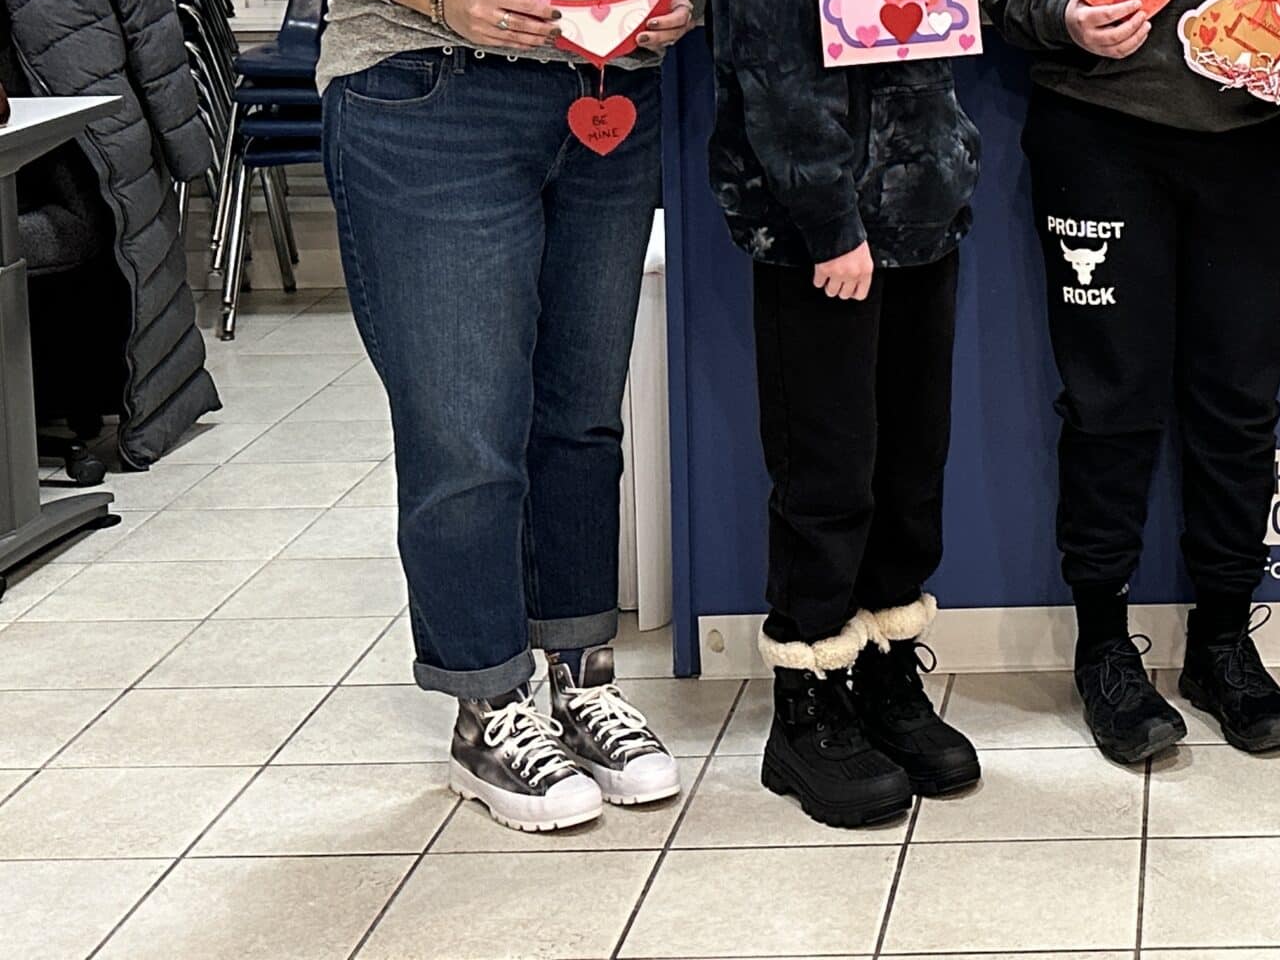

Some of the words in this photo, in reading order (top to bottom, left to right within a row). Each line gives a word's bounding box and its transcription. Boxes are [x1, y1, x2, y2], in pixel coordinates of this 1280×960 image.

[592, 113, 609, 126] BE
[1047, 215, 1125, 240] PROJECT
[1062, 285, 1117, 307] ROCK
